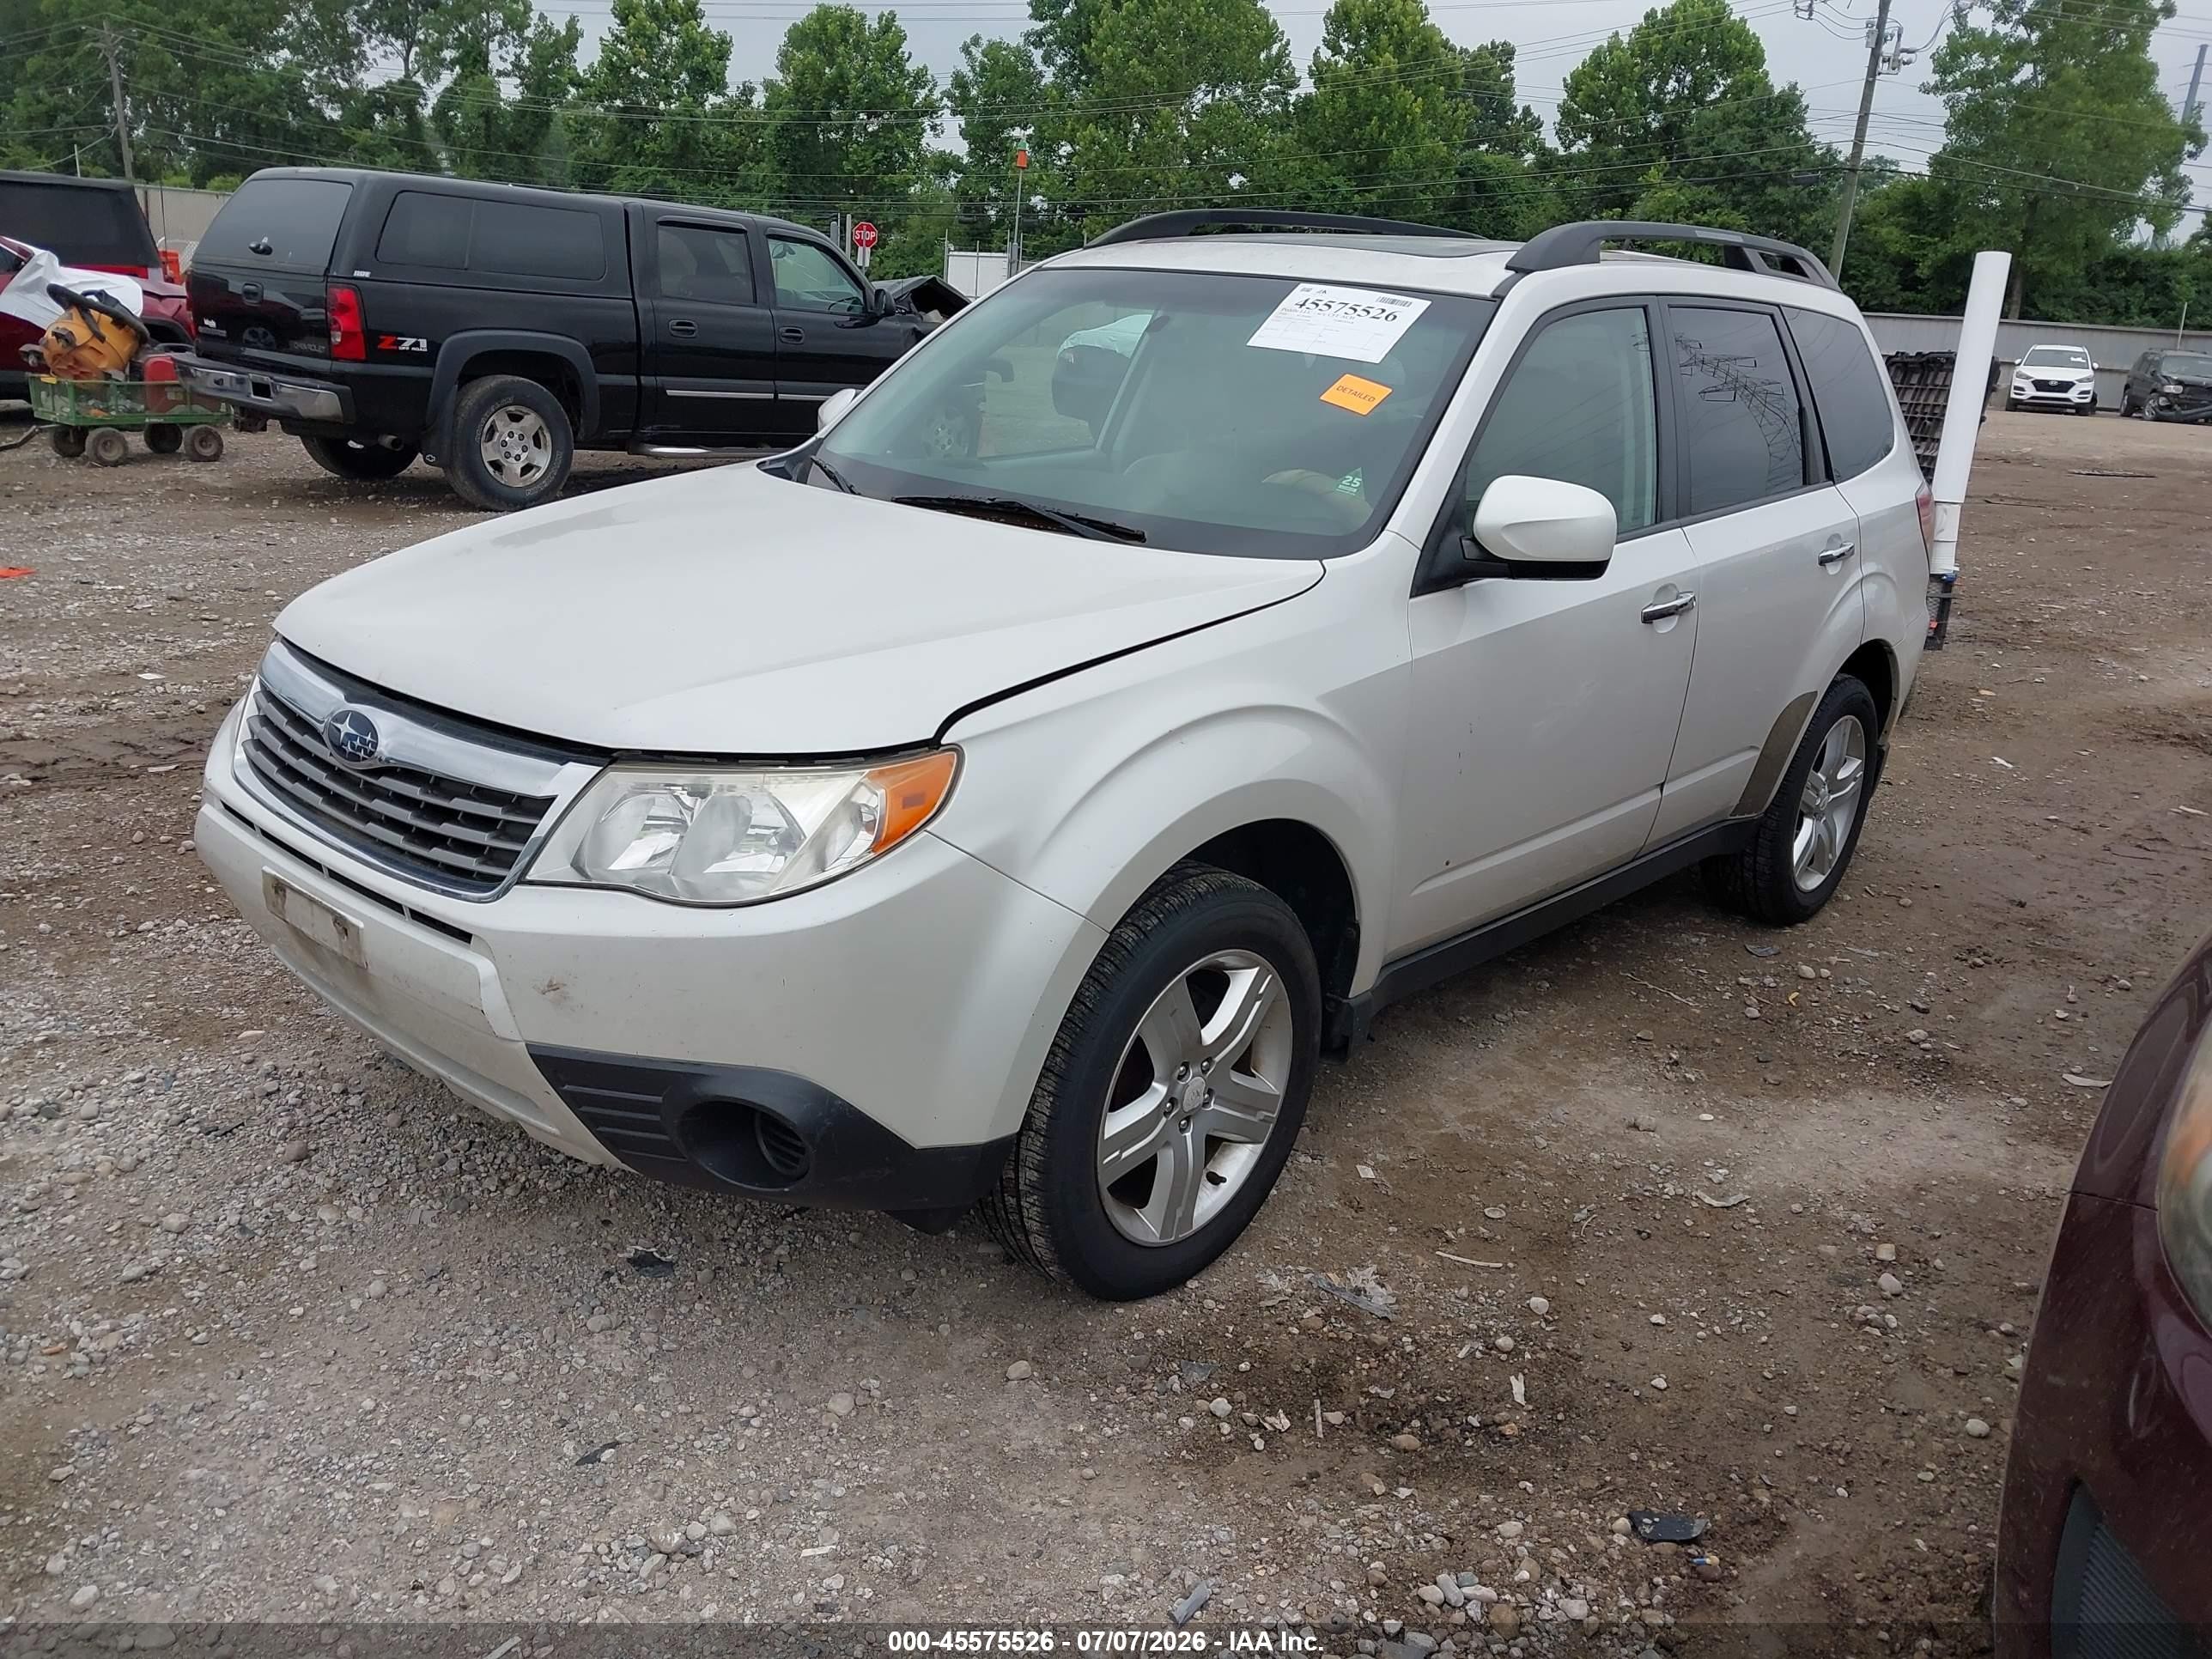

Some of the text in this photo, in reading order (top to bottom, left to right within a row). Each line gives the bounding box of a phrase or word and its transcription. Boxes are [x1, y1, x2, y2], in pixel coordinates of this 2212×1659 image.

[854, 230, 876, 240] STOP
[1294, 297, 1402, 323] 45575526
[377, 335, 428, 349] Z71
[1336, 385, 1376, 402] DETAILED
[1341, 475, 1363, 488] 25
